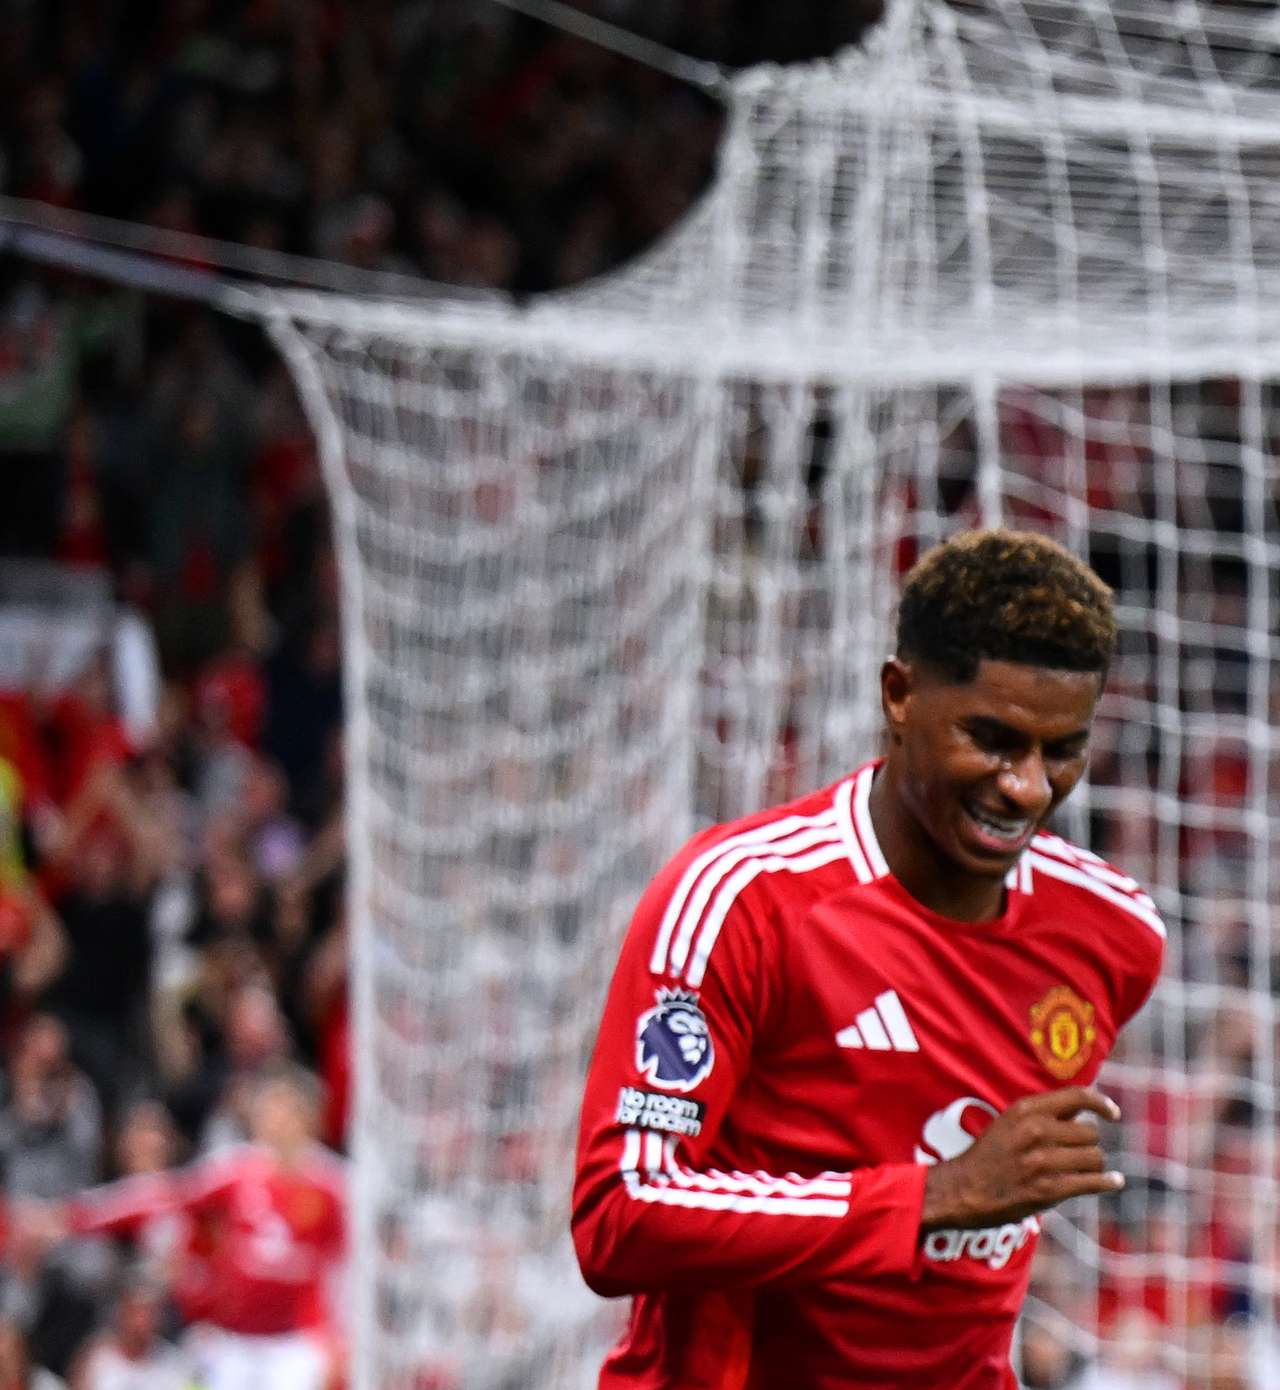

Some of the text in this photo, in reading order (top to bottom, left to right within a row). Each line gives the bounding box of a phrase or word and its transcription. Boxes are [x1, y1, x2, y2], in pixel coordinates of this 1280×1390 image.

[619, 1087, 699, 1118] No room
[640, 1109, 702, 1137] racism
